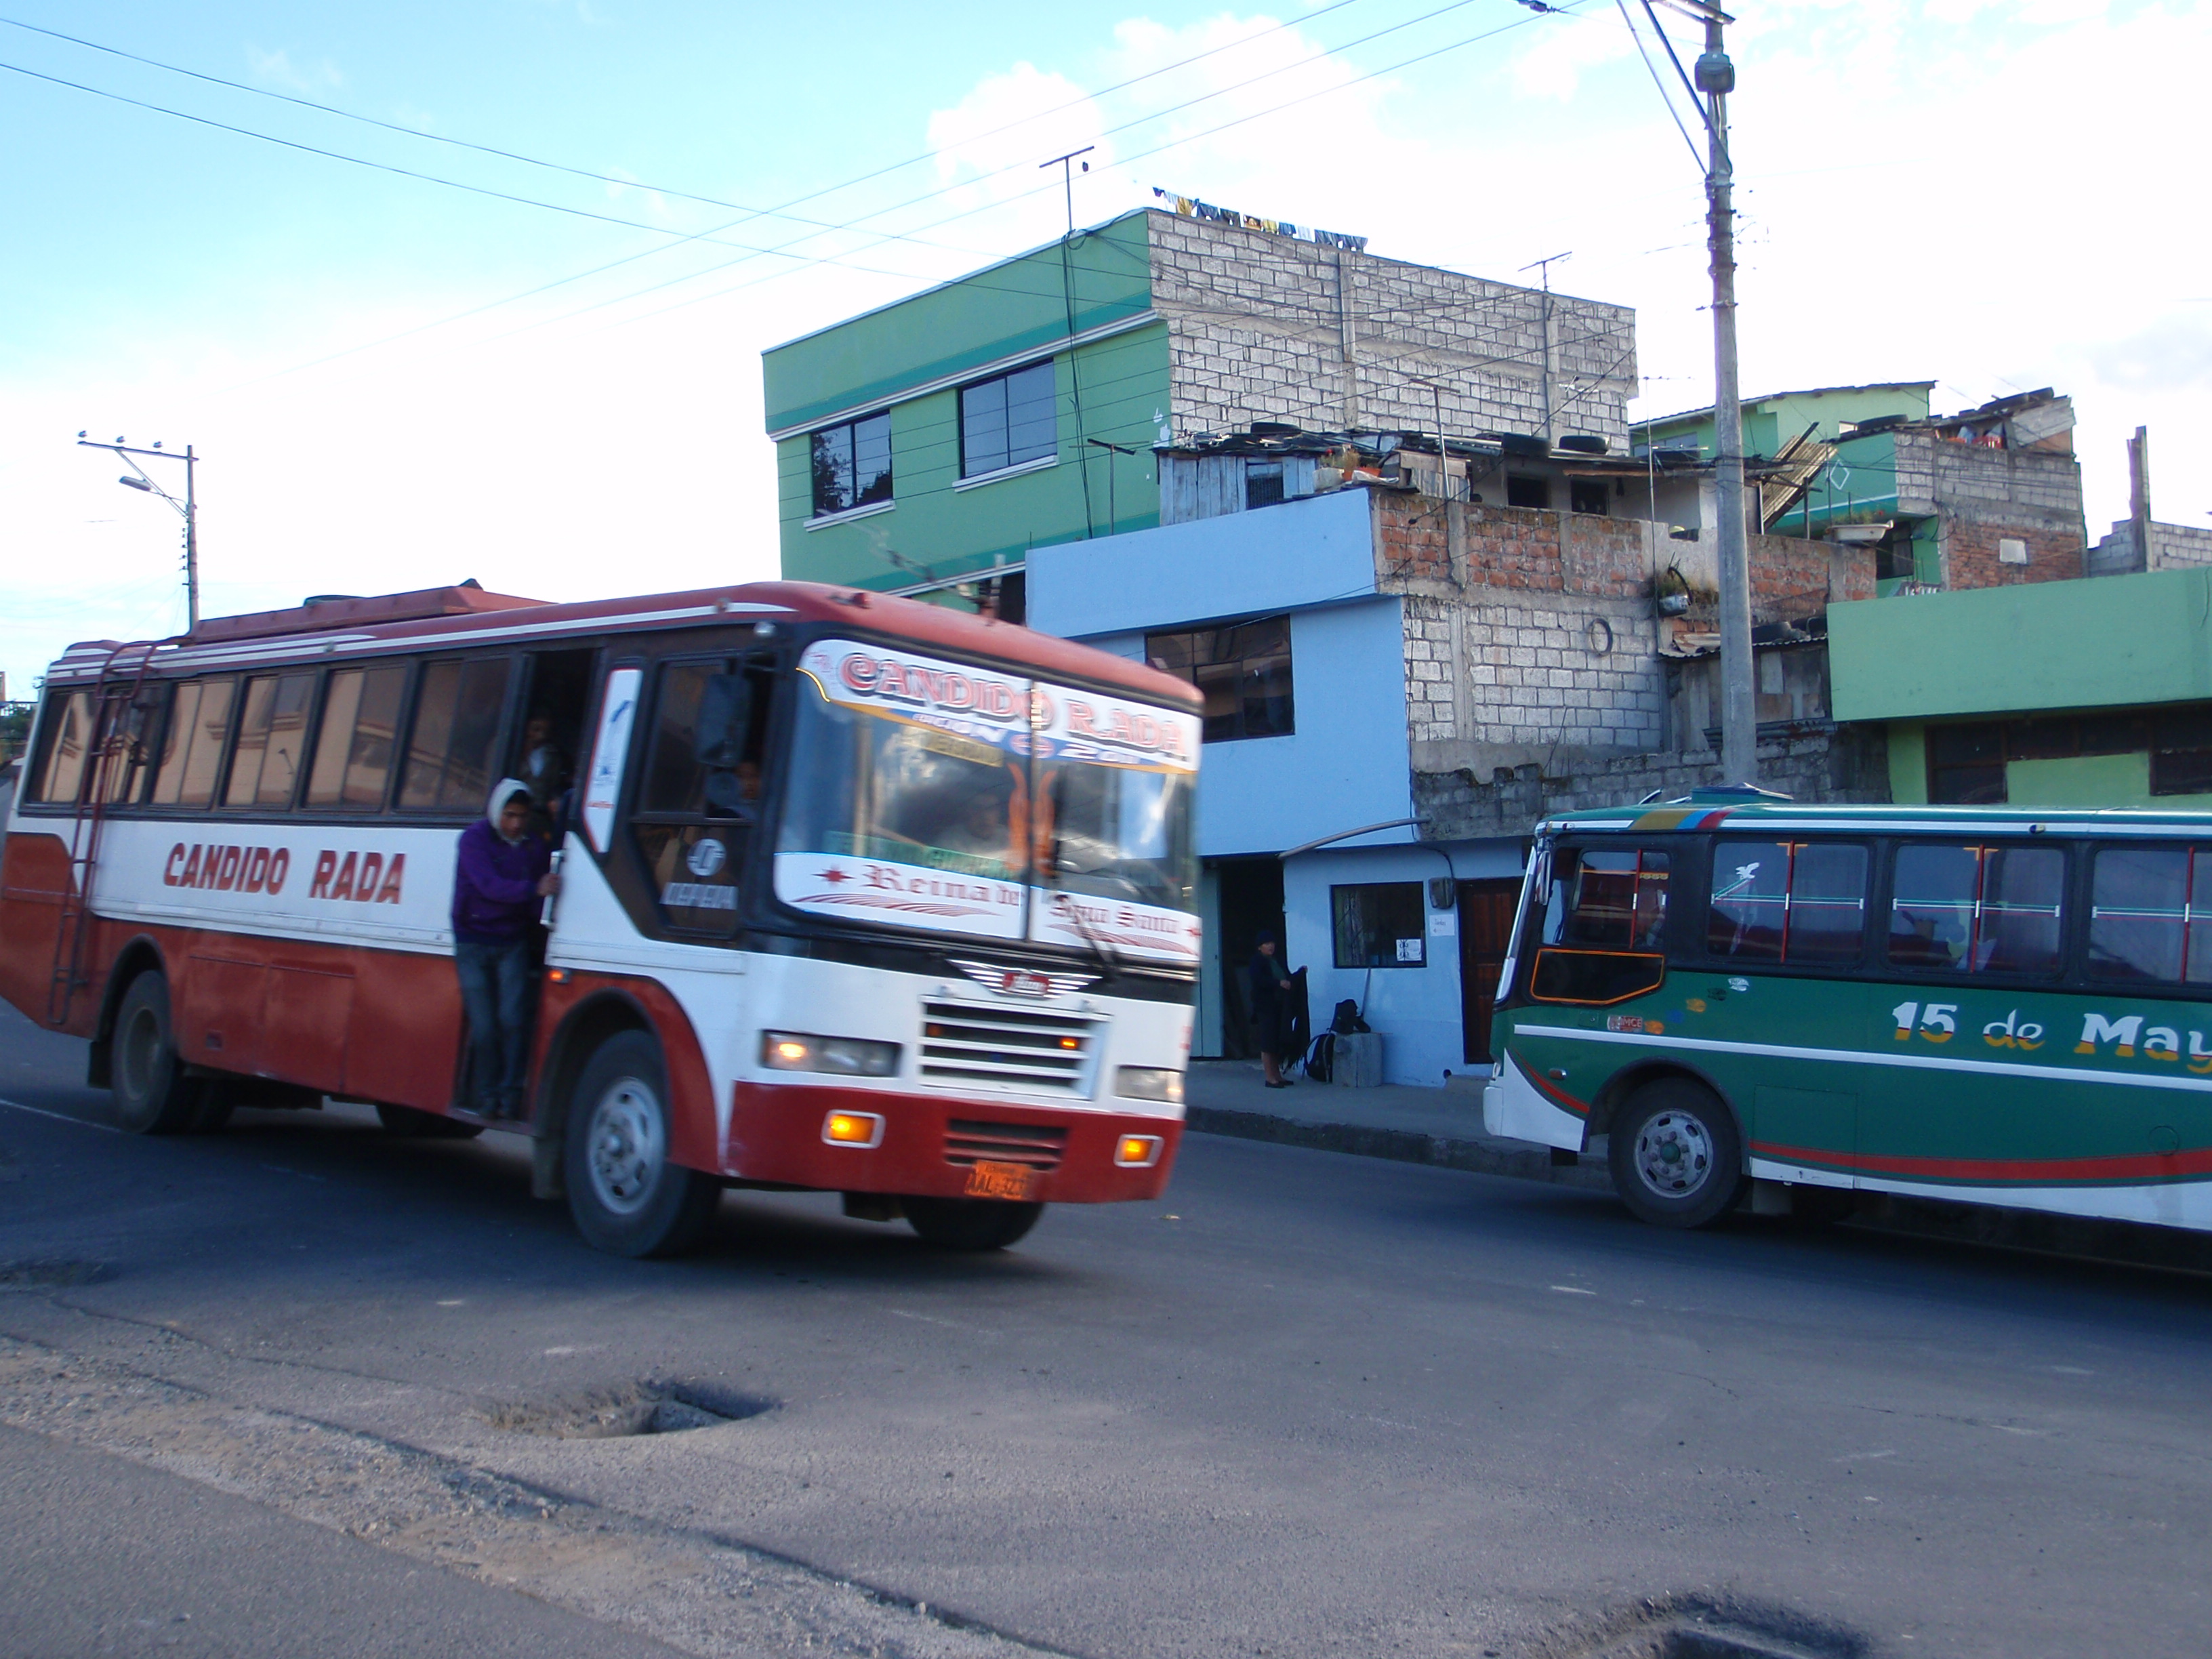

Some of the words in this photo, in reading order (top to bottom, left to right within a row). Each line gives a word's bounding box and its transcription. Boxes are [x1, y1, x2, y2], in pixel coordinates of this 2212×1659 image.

[838, 652, 1055, 731] CANDIDO
[1063, 699, 1190, 762] RADA
[163, 841, 290, 896] CANDIDO
[308, 849, 407, 905] RADA
[859, 864, 990, 902] Reina
[1891, 1000, 1959, 1044] 15
[1982, 1007, 2046, 1051] de
